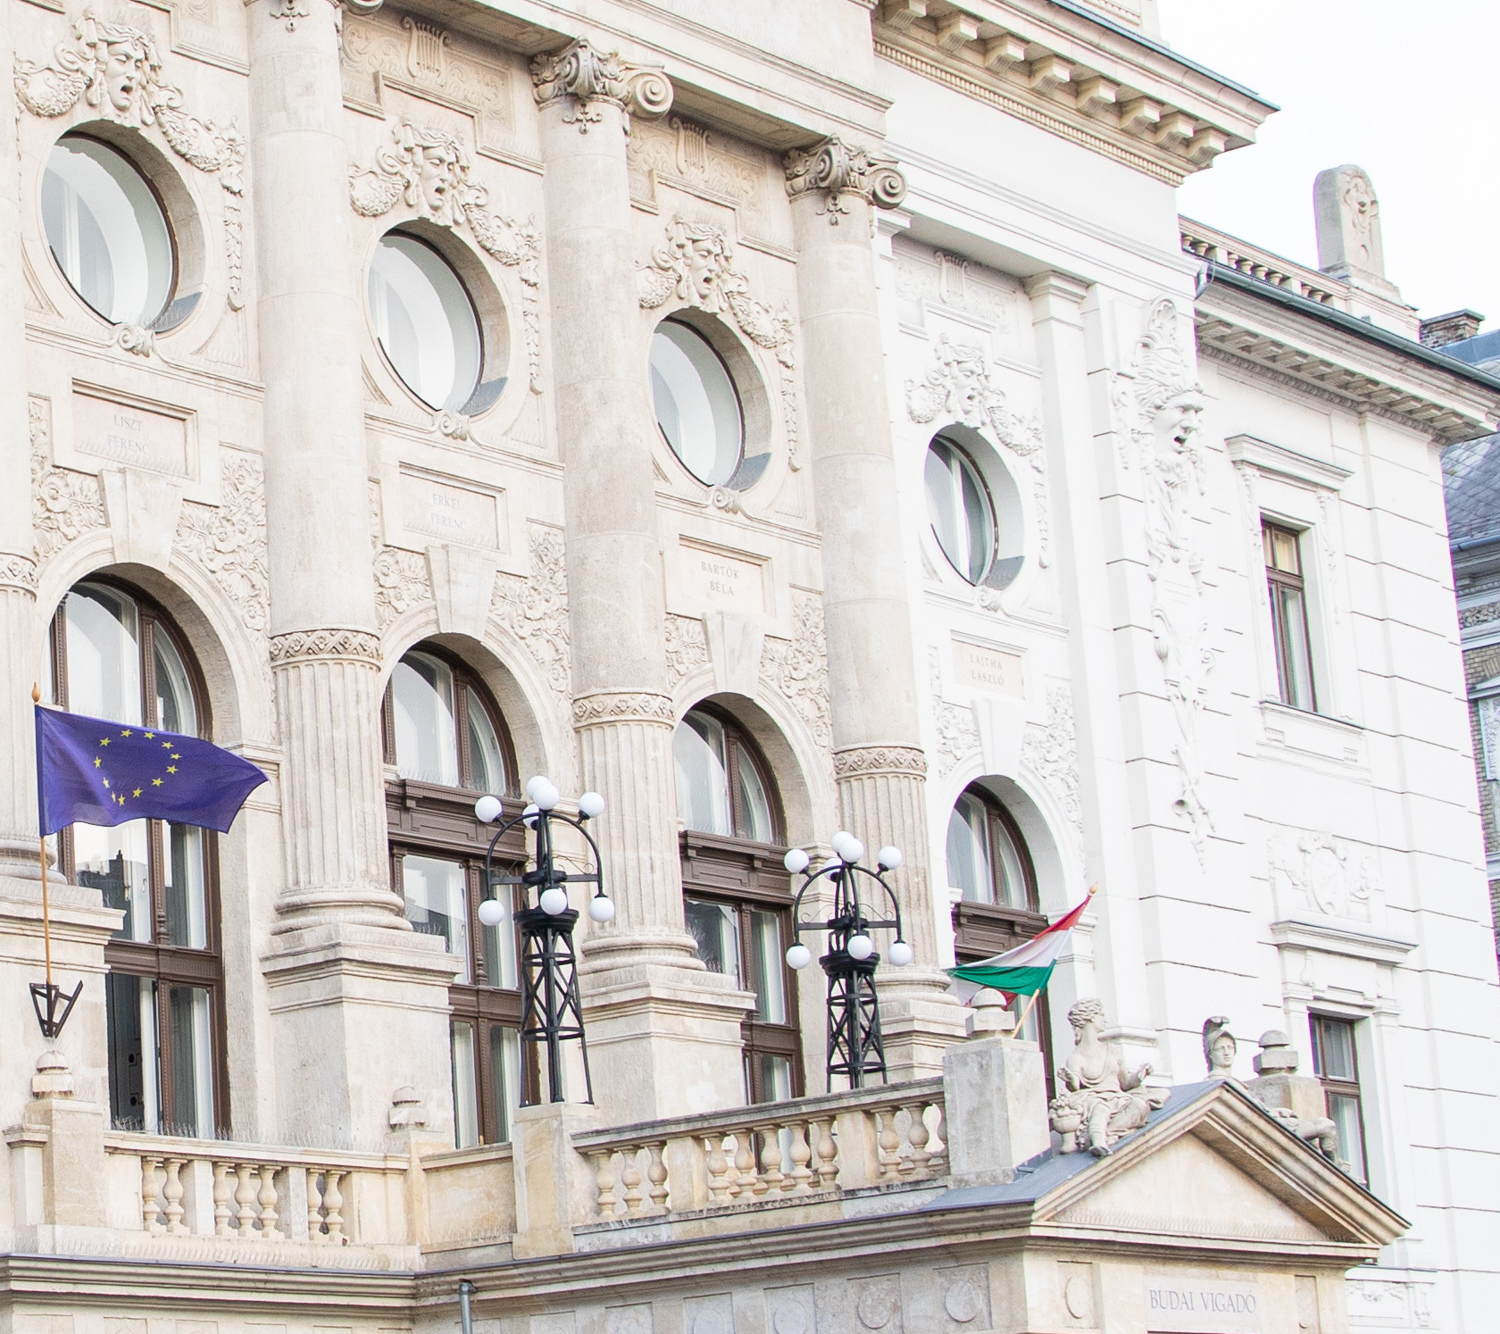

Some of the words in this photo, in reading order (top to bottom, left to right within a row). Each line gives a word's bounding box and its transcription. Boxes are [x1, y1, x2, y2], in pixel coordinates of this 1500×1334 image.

[113, 414, 143, 432] LISZT
[108, 434, 150, 454] FERENC
[432, 493, 463, 511] ERKEL
[430, 512, 466, 531] FERENC
[700, 561, 740, 580] BARTÓK
[709, 580, 734, 596] BÉLA
[970, 653, 1003, 670] LAJTHA
[1149, 1289, 1195, 1311] BUDAI
[1200, 1290, 1257, 1314] VIGADÓ
